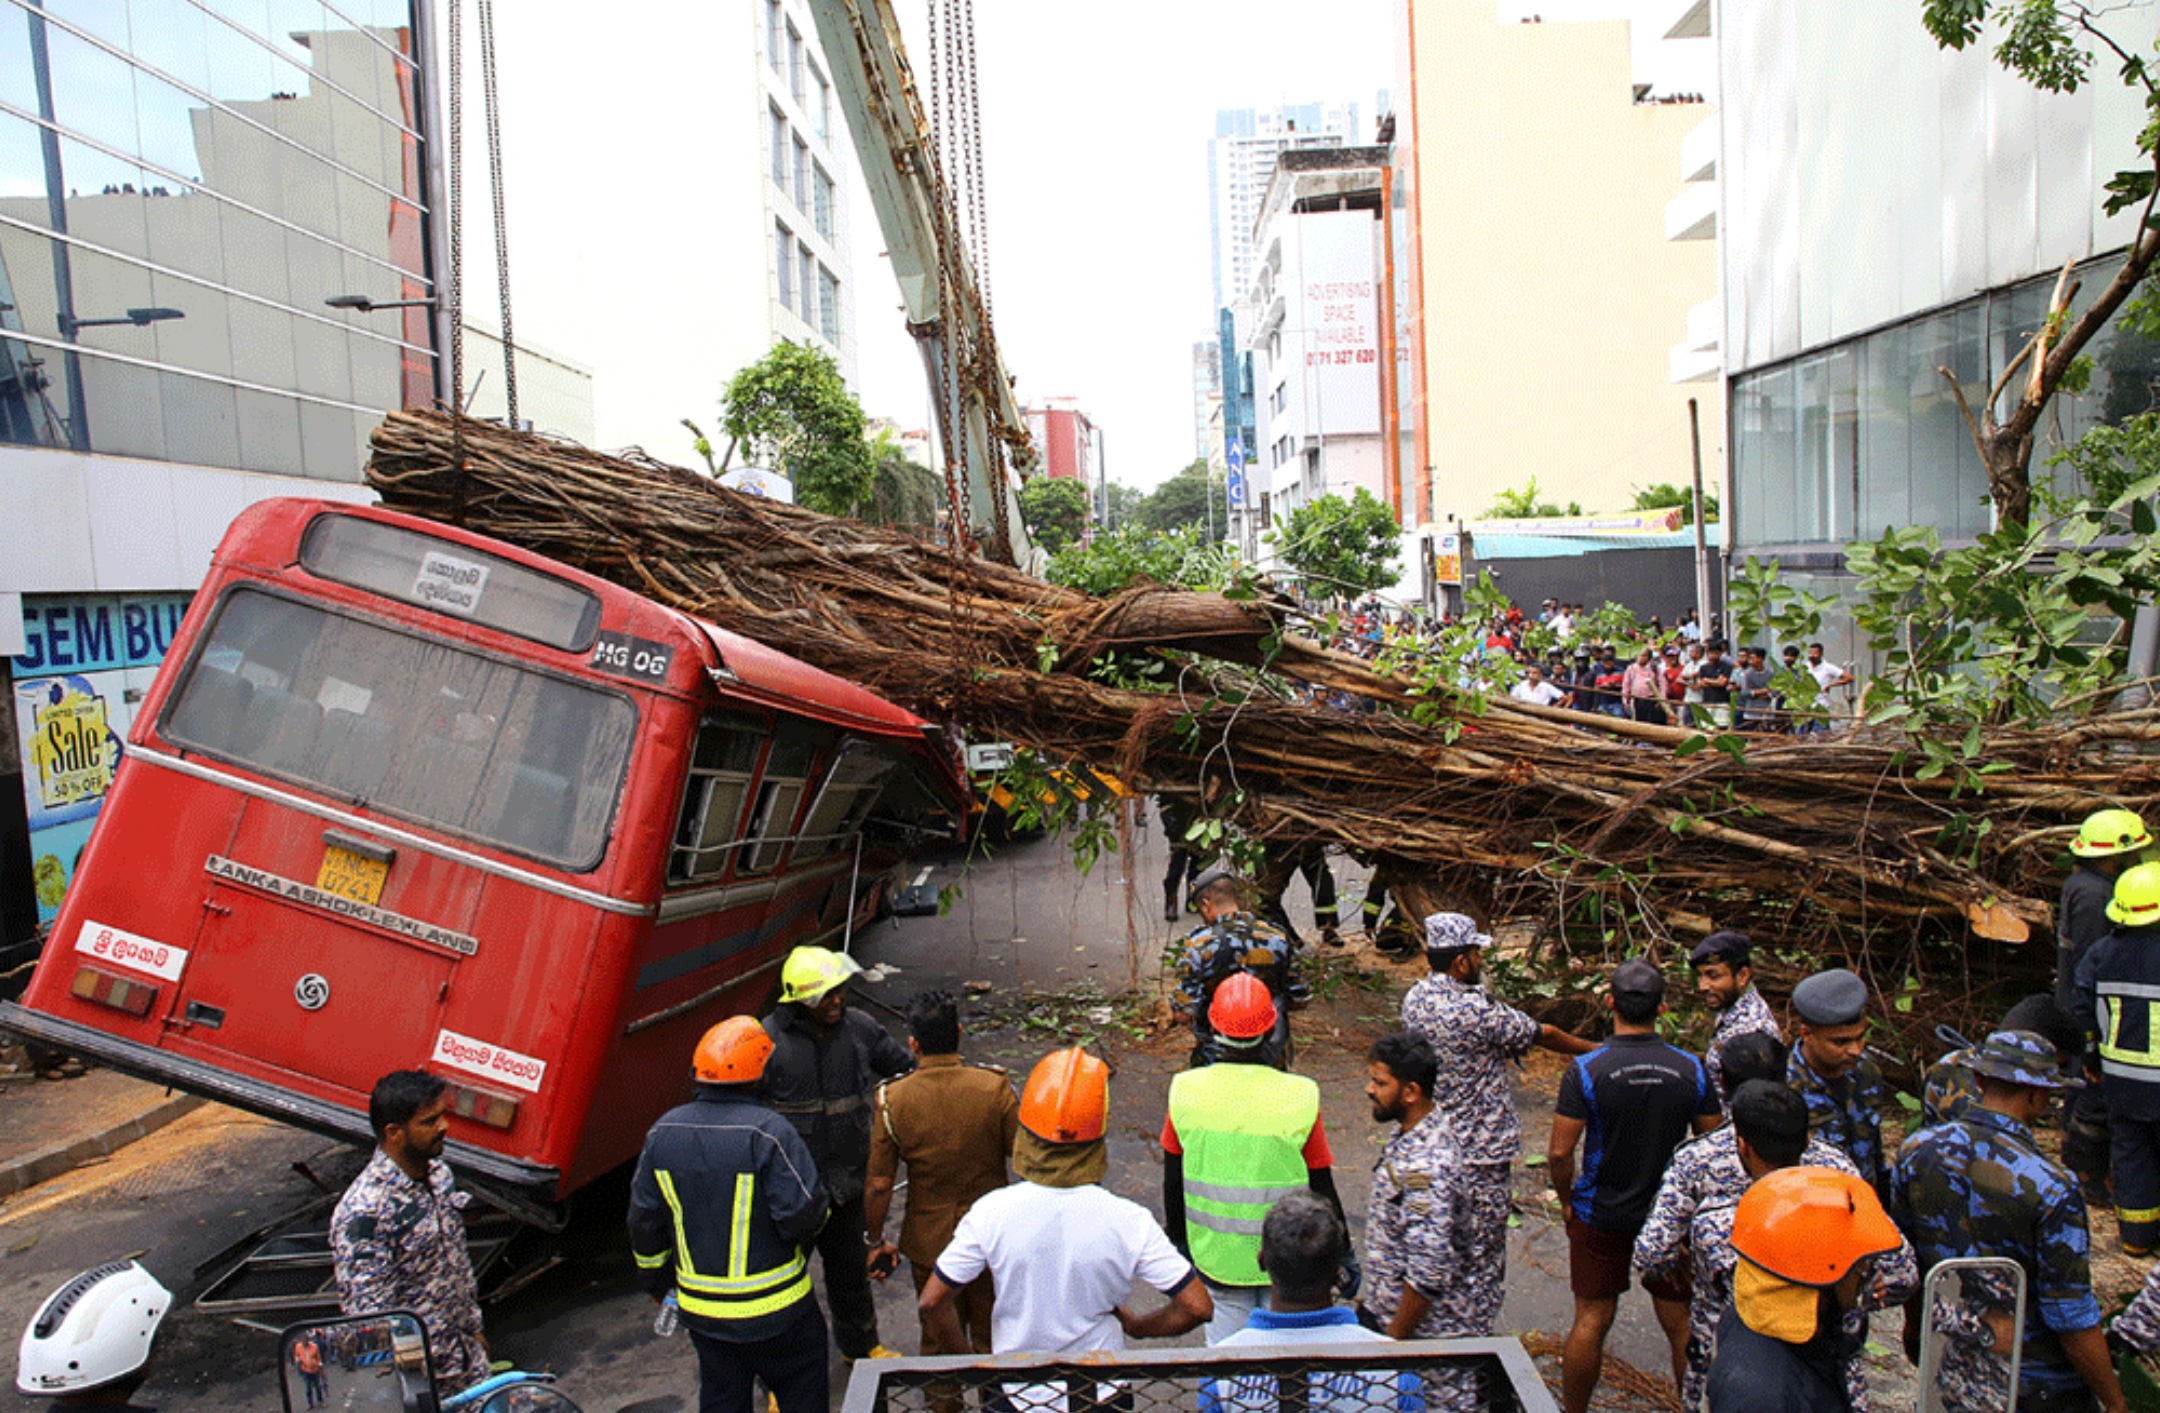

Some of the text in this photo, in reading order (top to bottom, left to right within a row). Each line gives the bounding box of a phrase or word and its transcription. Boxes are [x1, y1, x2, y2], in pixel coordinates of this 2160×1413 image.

[1323, 303, 1355, 322] SPACE
[1334, 349, 1354, 365] 327
[1356, 348, 1375, 363] 620
[13, 605, 116, 669] GEM
[593, 641, 666, 675] MG 06
[48, 717, 100, 774] Sale
[208, 856, 281, 895] LANKA
